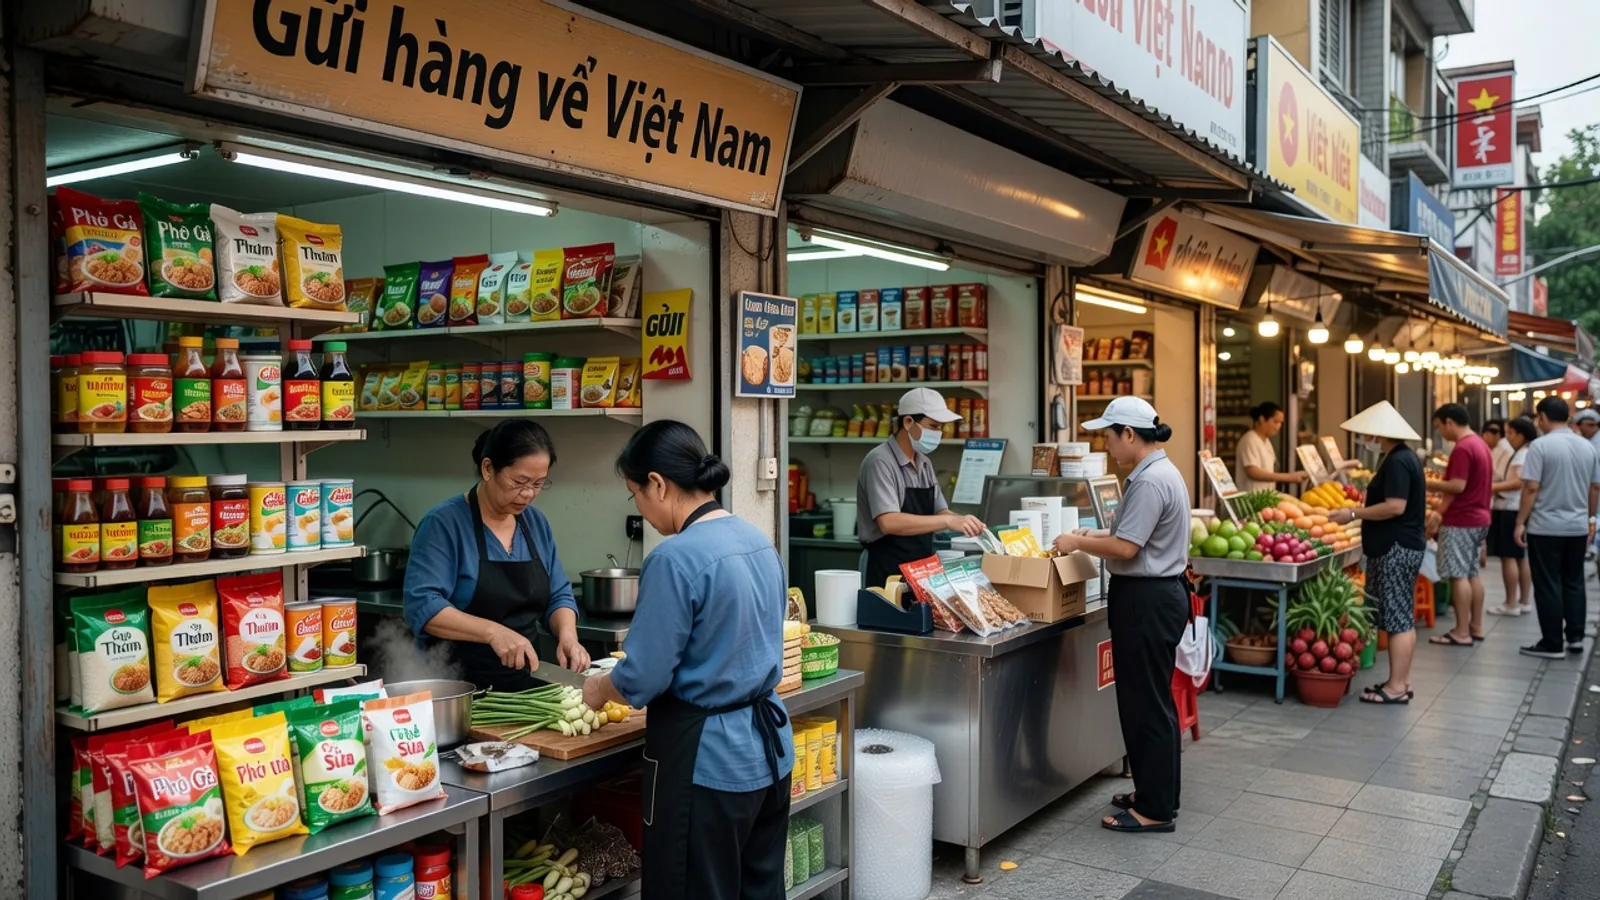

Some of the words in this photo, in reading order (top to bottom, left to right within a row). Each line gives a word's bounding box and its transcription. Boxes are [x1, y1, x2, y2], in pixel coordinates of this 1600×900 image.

[382, 5, 521, 130] hàng
[537, 55, 596, 129] vể
[606, 72, 684, 164] Việt
[691, 102, 772, 176] Nam
